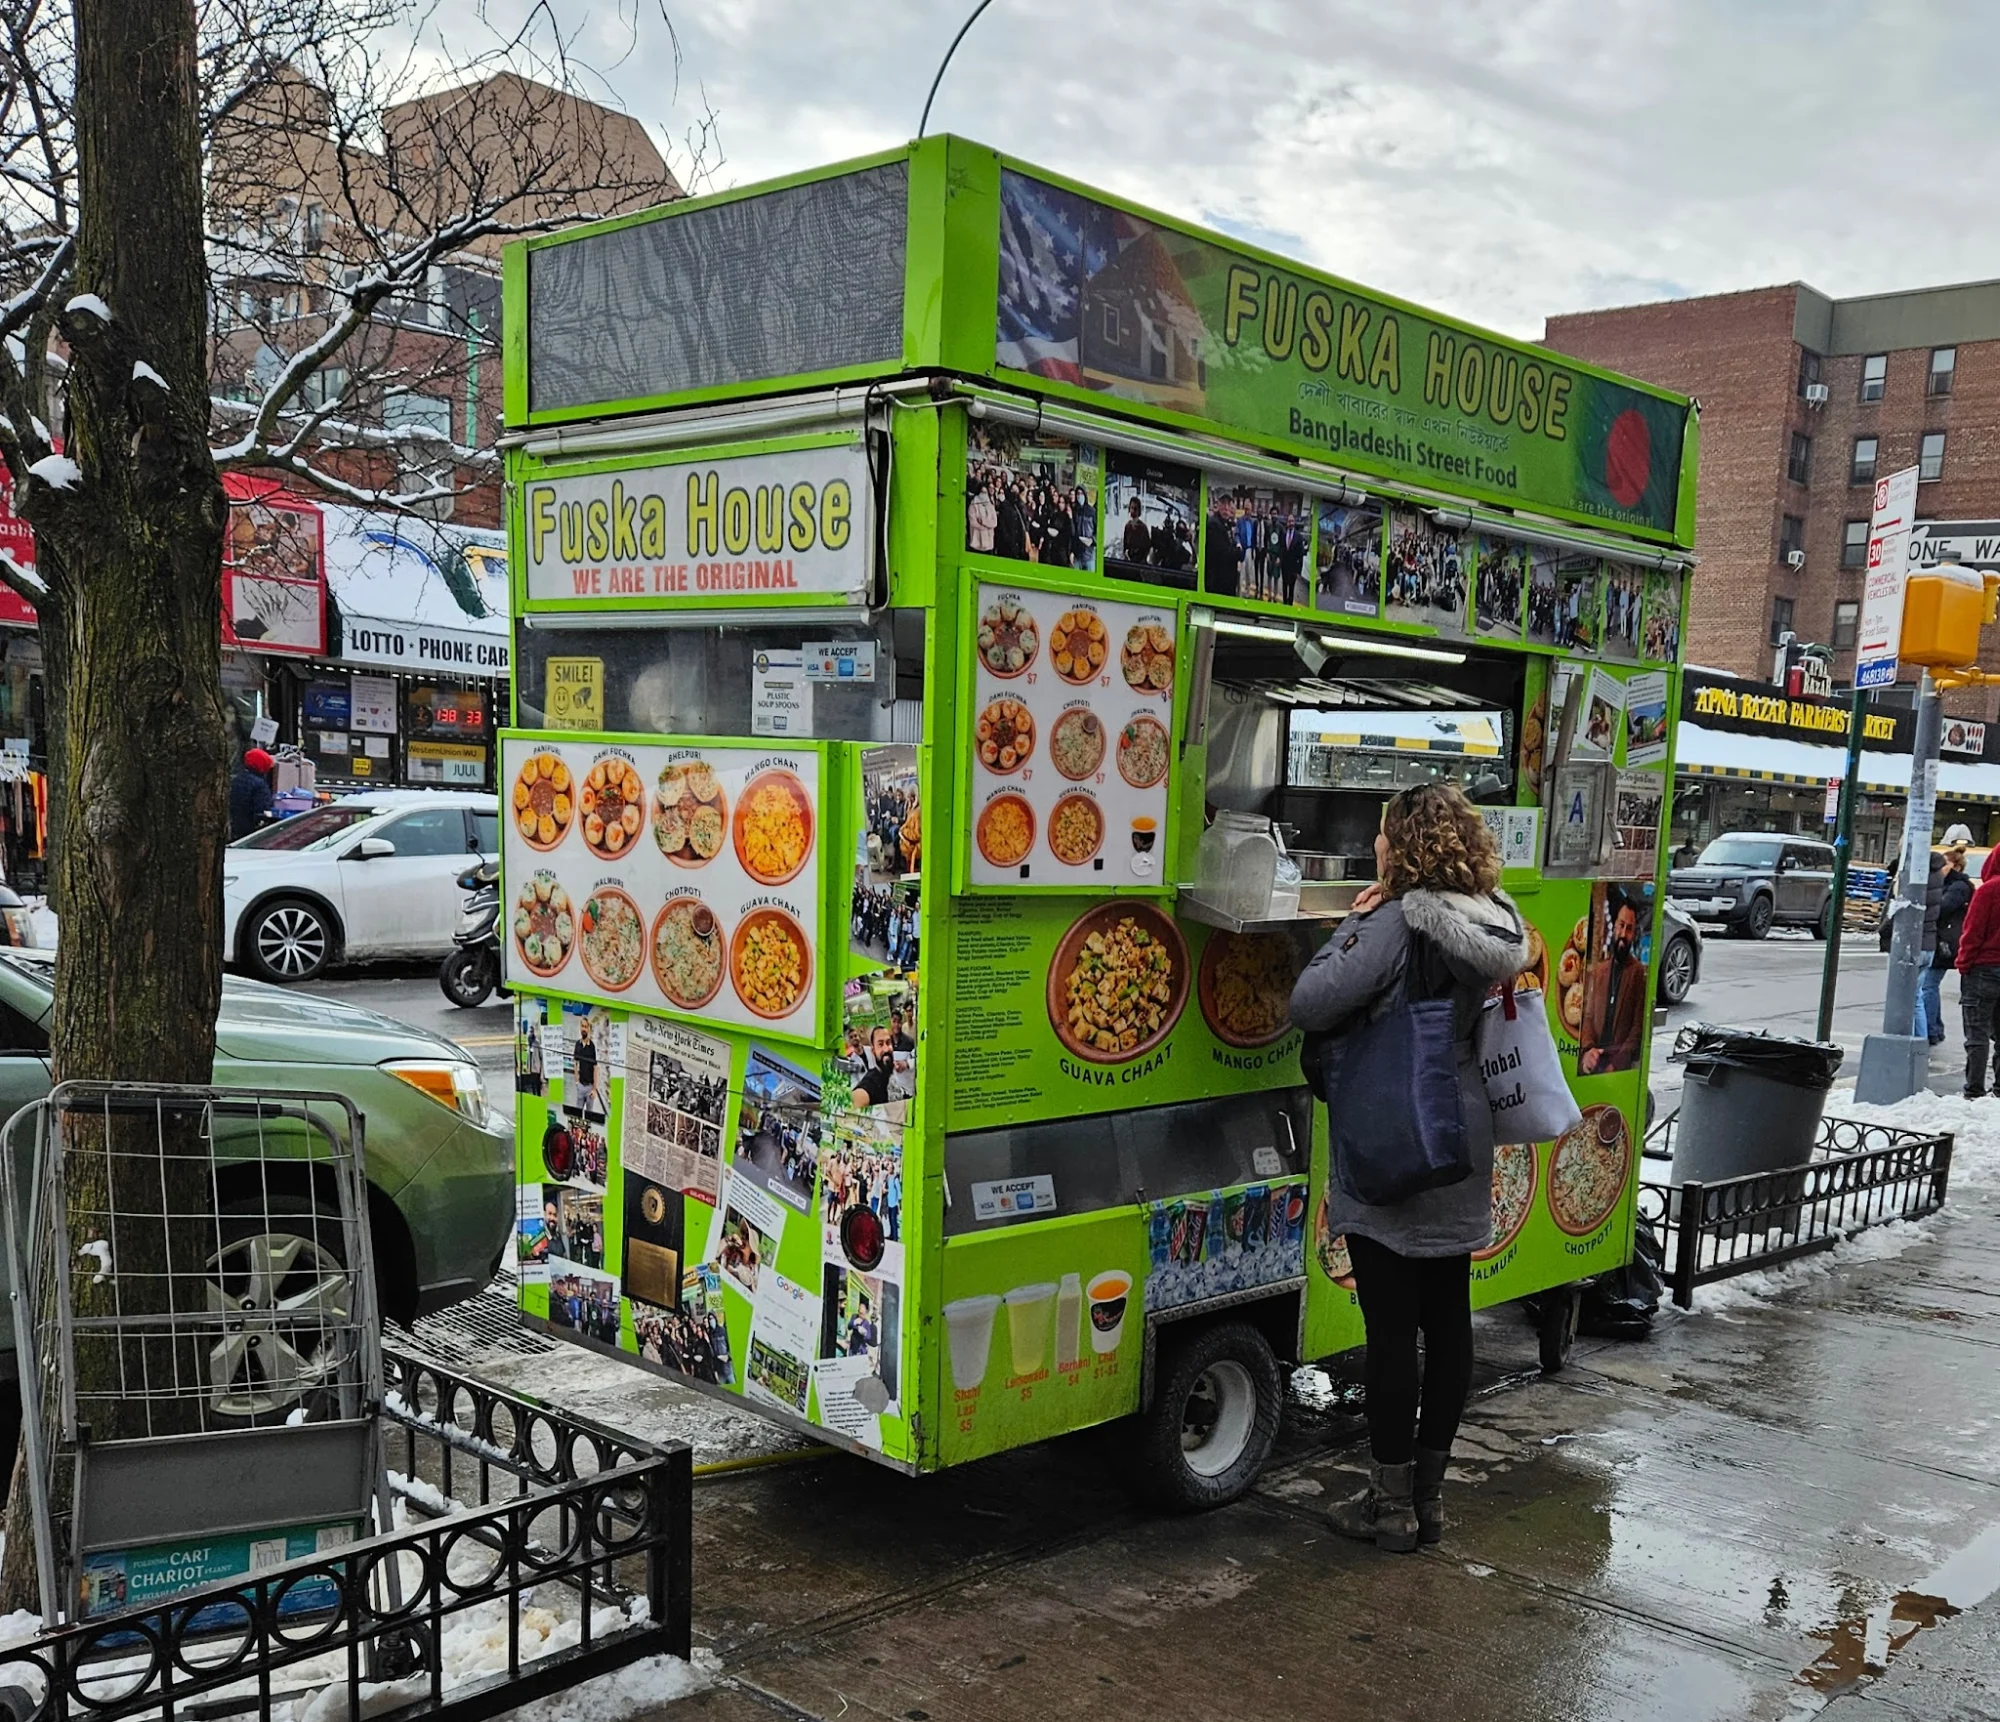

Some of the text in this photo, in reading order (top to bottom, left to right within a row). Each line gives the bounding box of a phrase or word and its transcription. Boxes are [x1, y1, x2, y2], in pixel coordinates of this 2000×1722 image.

[1224, 264, 1572, 441] FUSKA HOUSE
[1289, 406, 1518, 489] Bangladeshi Street Food
[531, 470, 852, 565] Fuska House
[1577, 500, 1595, 514] are
[1597, 502, 1613, 518] the
[1616, 508, 1655, 529] original
[1871, 544, 1881, 562] 30
[1908, 540, 1951, 561] ONE
[1975, 539, 2000, 560] WA
[573, 559, 798, 595] WE ARE THE ORIGINAL
[351, 628, 509, 668] LOTTO PHONE CAR
[818, 647, 858, 657] WE ACCEPT
[555, 664, 593, 683] SMILE!
[807, 663, 819, 671] VISA
[1809, 661, 1829, 678] APNA
[1026, 672, 1038, 686] $7
[1100, 676, 1111, 688] $7
[1803, 672, 1833, 699] BAZAR
[766, 692, 791, 700] PLASTIC
[775, 701, 800, 709] SPOONS
[466, 710, 482, 724] 33
[1695, 686, 1743, 717] APNA
[1740, 693, 1787, 724] BAZAR
[1789, 701, 1846, 733] FARMERS
[1847, 710, 1897, 741] RKET
[533, 745, 561, 756] PANIPURI
[609, 747, 636, 766] FUCHKA
[668, 750, 702, 763] BHELPURI
[453, 763, 477, 777] JUUL
[744, 757, 799, 783] MANGO CHAAT
[1022, 769, 1033, 781] $7
[1096, 773, 1105, 784] $7
[1568, 790, 1584, 824] A
[534, 868, 557, 879] FUCHKA
[665, 887, 702, 901] CHOTPOTI
[740, 896, 801, 919] GUAVA CHAAT
[644, 1018, 715, 1056] The New York Times
[1559, 1037, 1580, 1057] DAH
[1212, 1031, 1304, 1071] MANGO CHAA
[1059, 1042, 1174, 1086] GUAVA CHAAT
[1489, 1081, 1527, 1114] ocal
[991, 1181, 1035, 1195] WE ACCEPT
[980, 1201, 995, 1210] VISA
[1564, 1222, 1614, 1256] CHOTPOTI
[1470, 1246, 1518, 1281] HALMURI
[777, 1276, 804, 1300] Google
[1004, 1368, 1050, 1390] Lemonade
[1068, 1373, 1079, 1387] $4
[1021, 1386, 1032, 1401] $5
[133, 1547, 212, 1569] FOLDING CART
[131, 1564, 233, 1589] CHARIOT PLIANT
